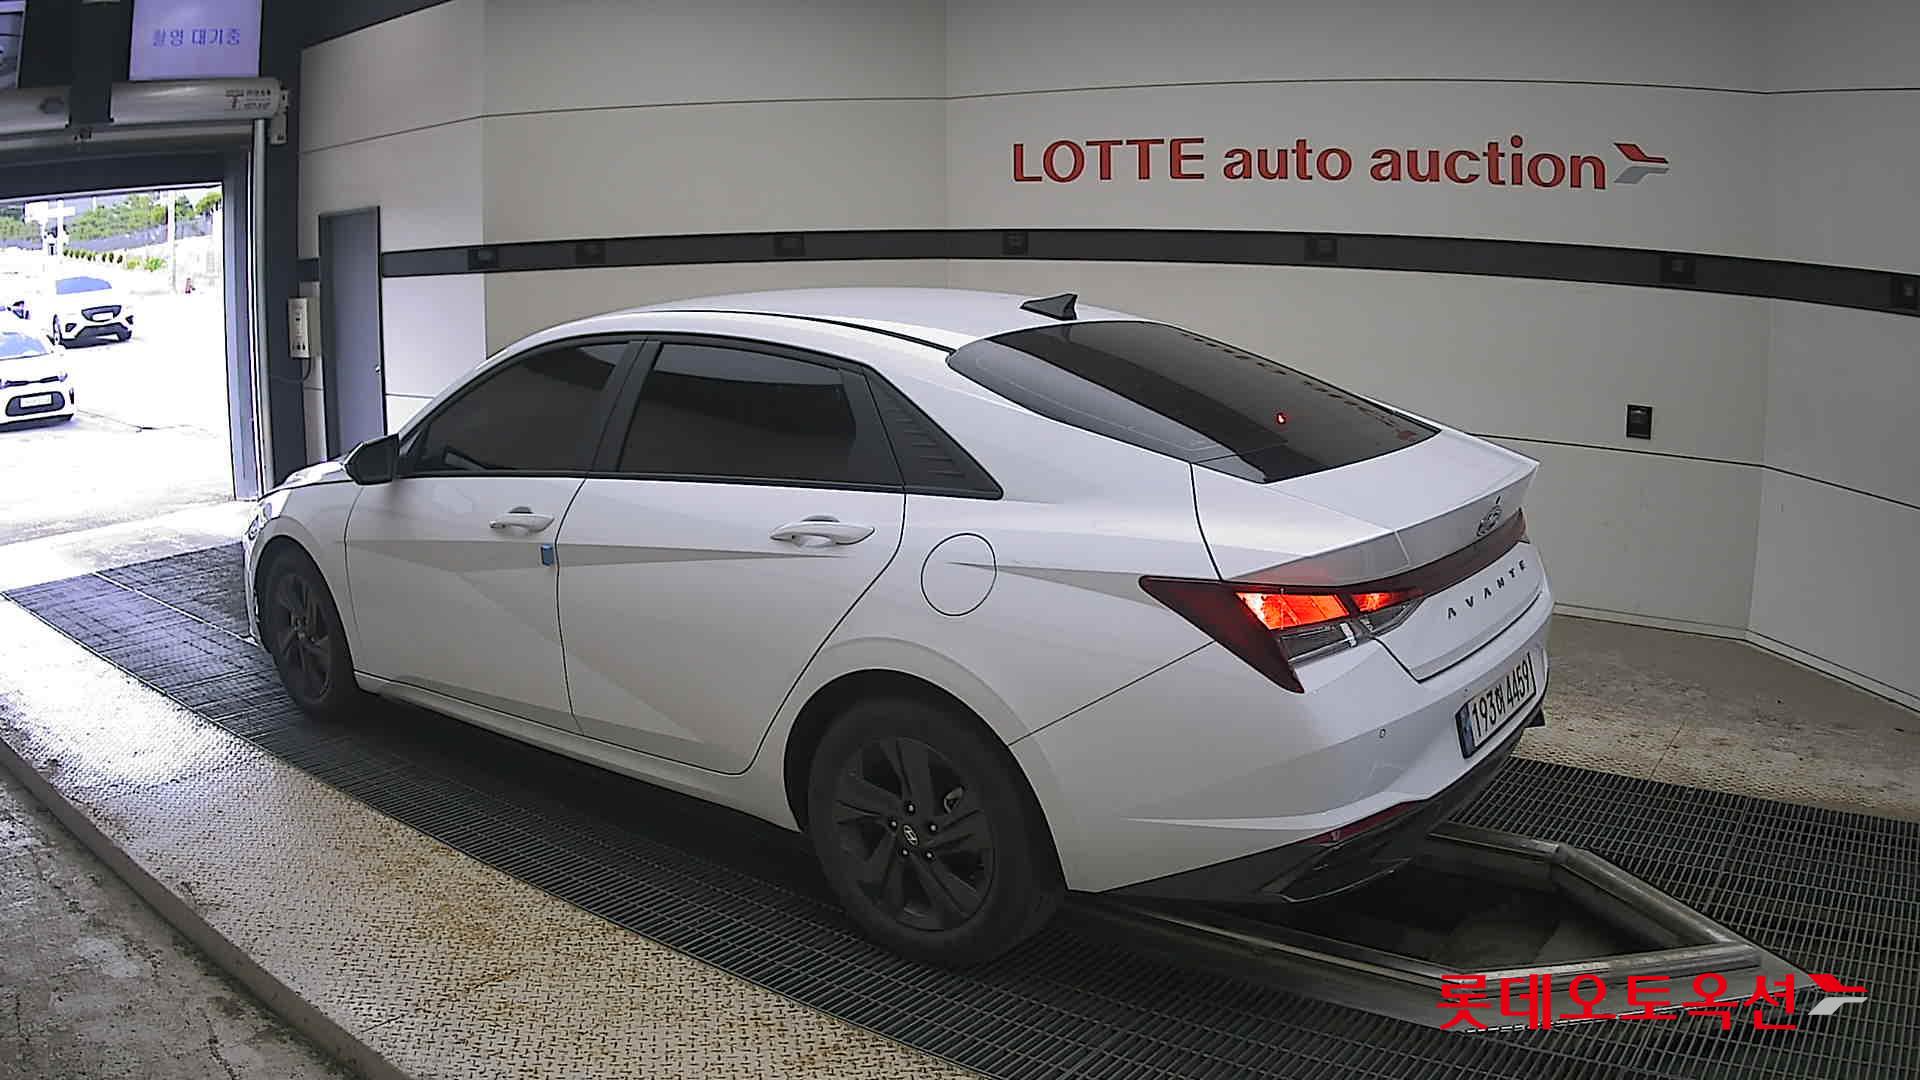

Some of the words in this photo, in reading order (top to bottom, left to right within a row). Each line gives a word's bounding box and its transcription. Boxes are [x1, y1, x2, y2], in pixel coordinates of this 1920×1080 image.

[1013, 137, 1204, 183] LOTTE
[1222, 138, 1353, 181] auto
[1369, 135, 1607, 189] auction
[1447, 560, 1528, 619] AVANTE
